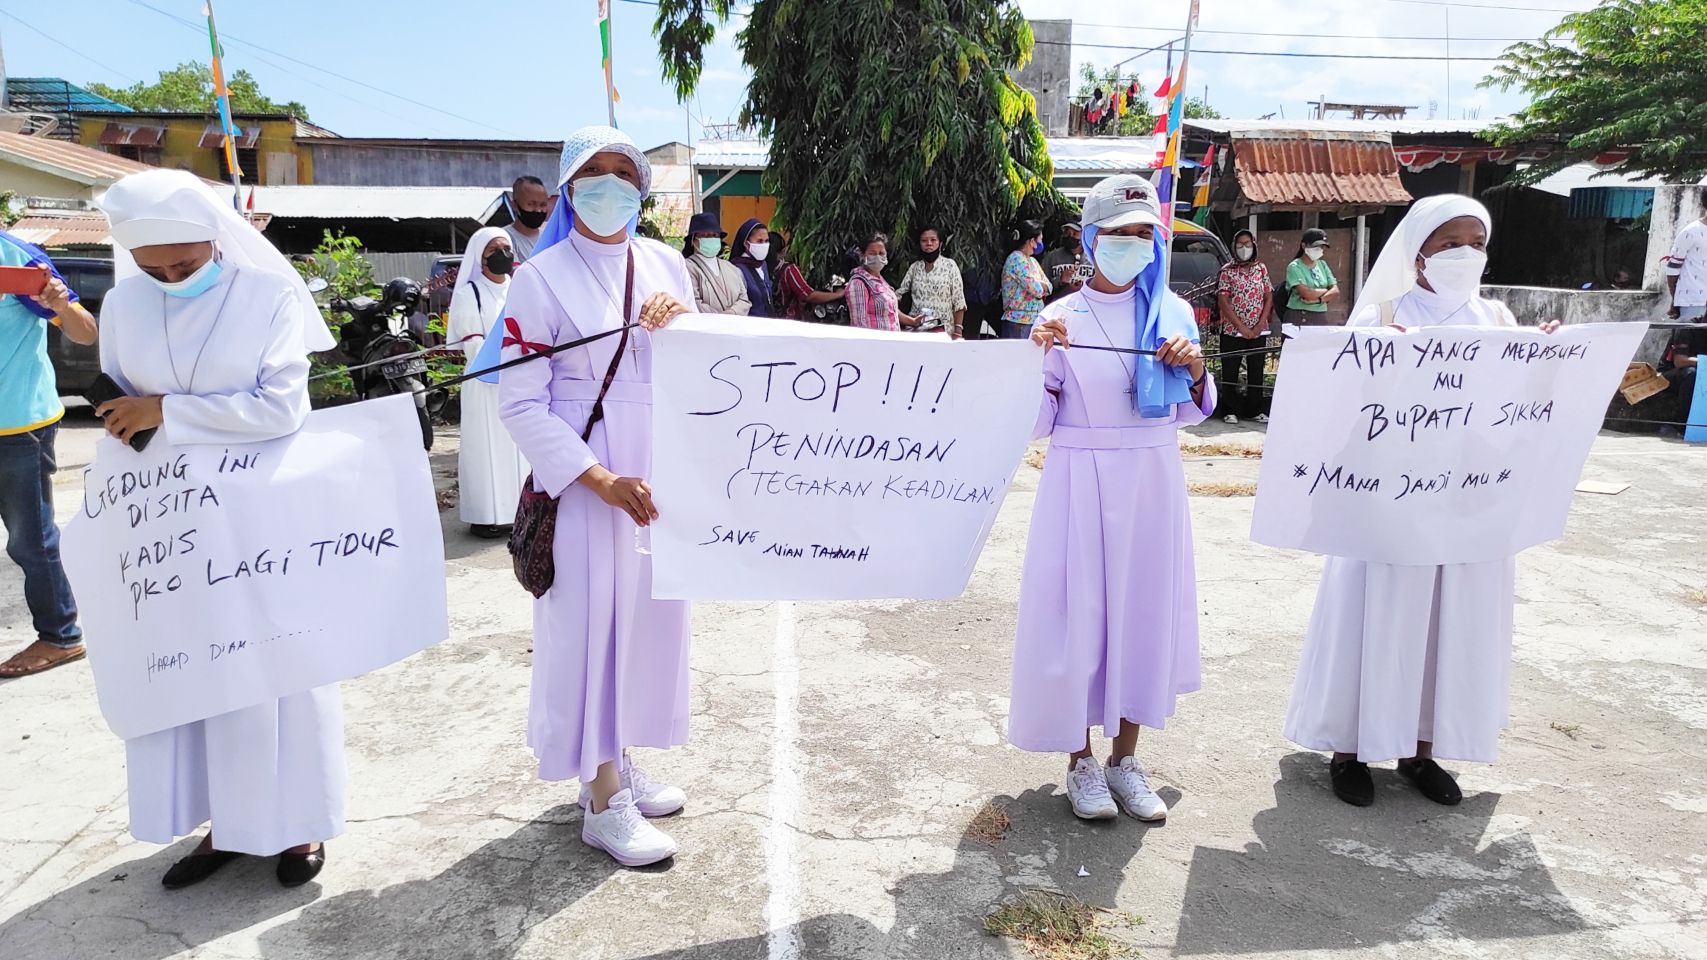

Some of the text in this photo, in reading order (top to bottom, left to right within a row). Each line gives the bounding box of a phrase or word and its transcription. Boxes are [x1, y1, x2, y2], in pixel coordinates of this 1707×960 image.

[1125, 189, 1148, 201] Lee
[1331, 331, 1395, 376] APA
[1412, 338, 1481, 369] YANG
[1433, 372, 1463, 391] MU
[1360, 400, 1554, 442] BUPATI SIKKA
[736, 422, 957, 470] PENINDASAN
[83, 453, 191, 519] GEDUNG
[119, 529, 197, 584] KADIS
[698, 525, 760, 545] SAVE
[130, 575, 183, 620] PKO
